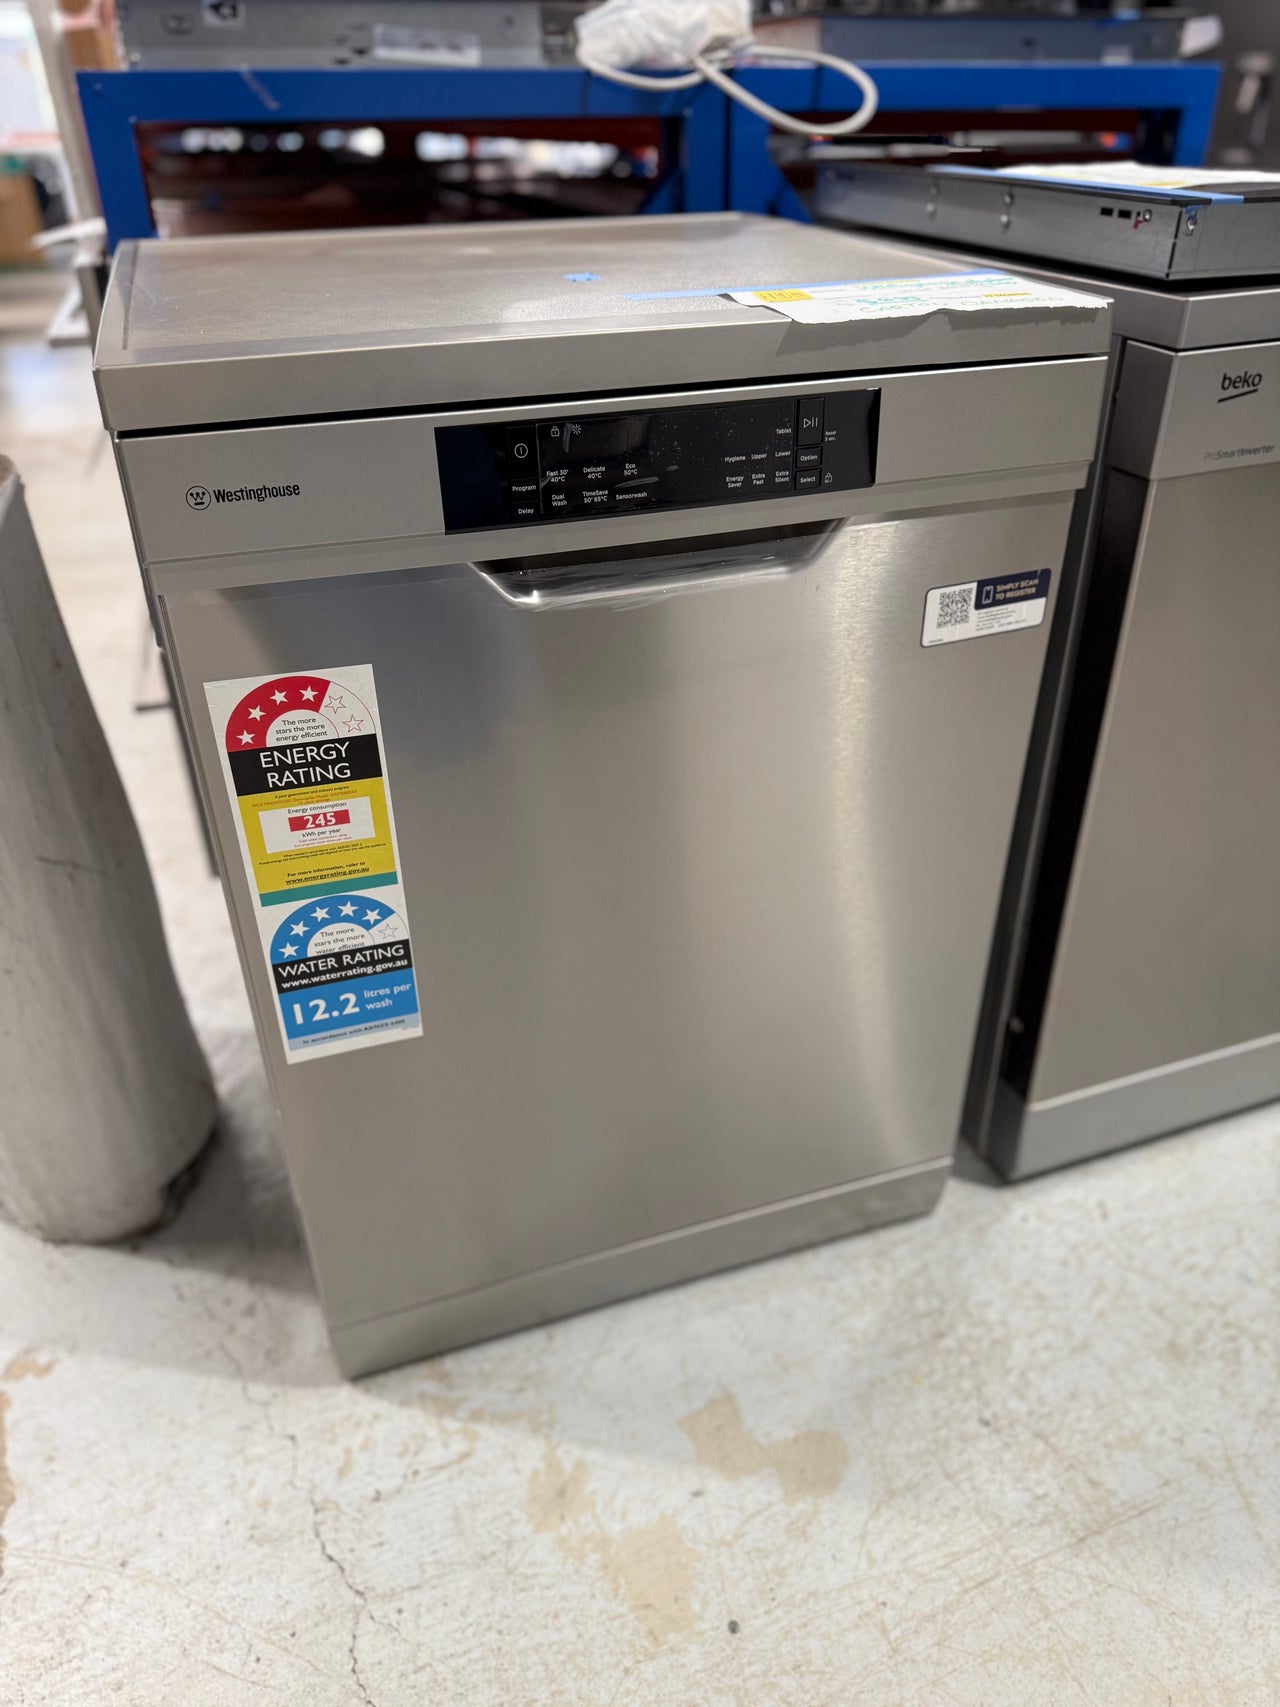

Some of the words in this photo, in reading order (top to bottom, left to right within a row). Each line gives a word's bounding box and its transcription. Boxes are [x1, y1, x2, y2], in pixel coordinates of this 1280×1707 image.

[1221, 371, 1263, 391] beko
[724, 455, 746, 463] Hygiene
[213, 484, 300, 503] Westinghouse
[616, 492, 647, 500] Sensorwash
[996, 583, 1019, 592] SIMPLY
[1020, 578, 1039, 587] SCAN
[1006, 587, 1036, 598] REGISTER
[301, 730, 328, 739] efficient
[260, 742, 350, 768] ENERGY
[267, 763, 351, 788] RATING
[310, 802, 347, 811] consumption
[304, 812, 336, 829] 245
[285, 867, 369, 885] www.energyrating.gov.au
[338, 942, 365, 950] efficient
[278, 958, 338, 977] WATER
[342, 944, 404, 966] RATING
[282, 959, 408, 989] www.waterrating.gov.au
[293, 992, 360, 1025] 12.2
[364, 988, 390, 998] litres
[394, 983, 412, 994] per
[366, 998, 392, 1010] wash
